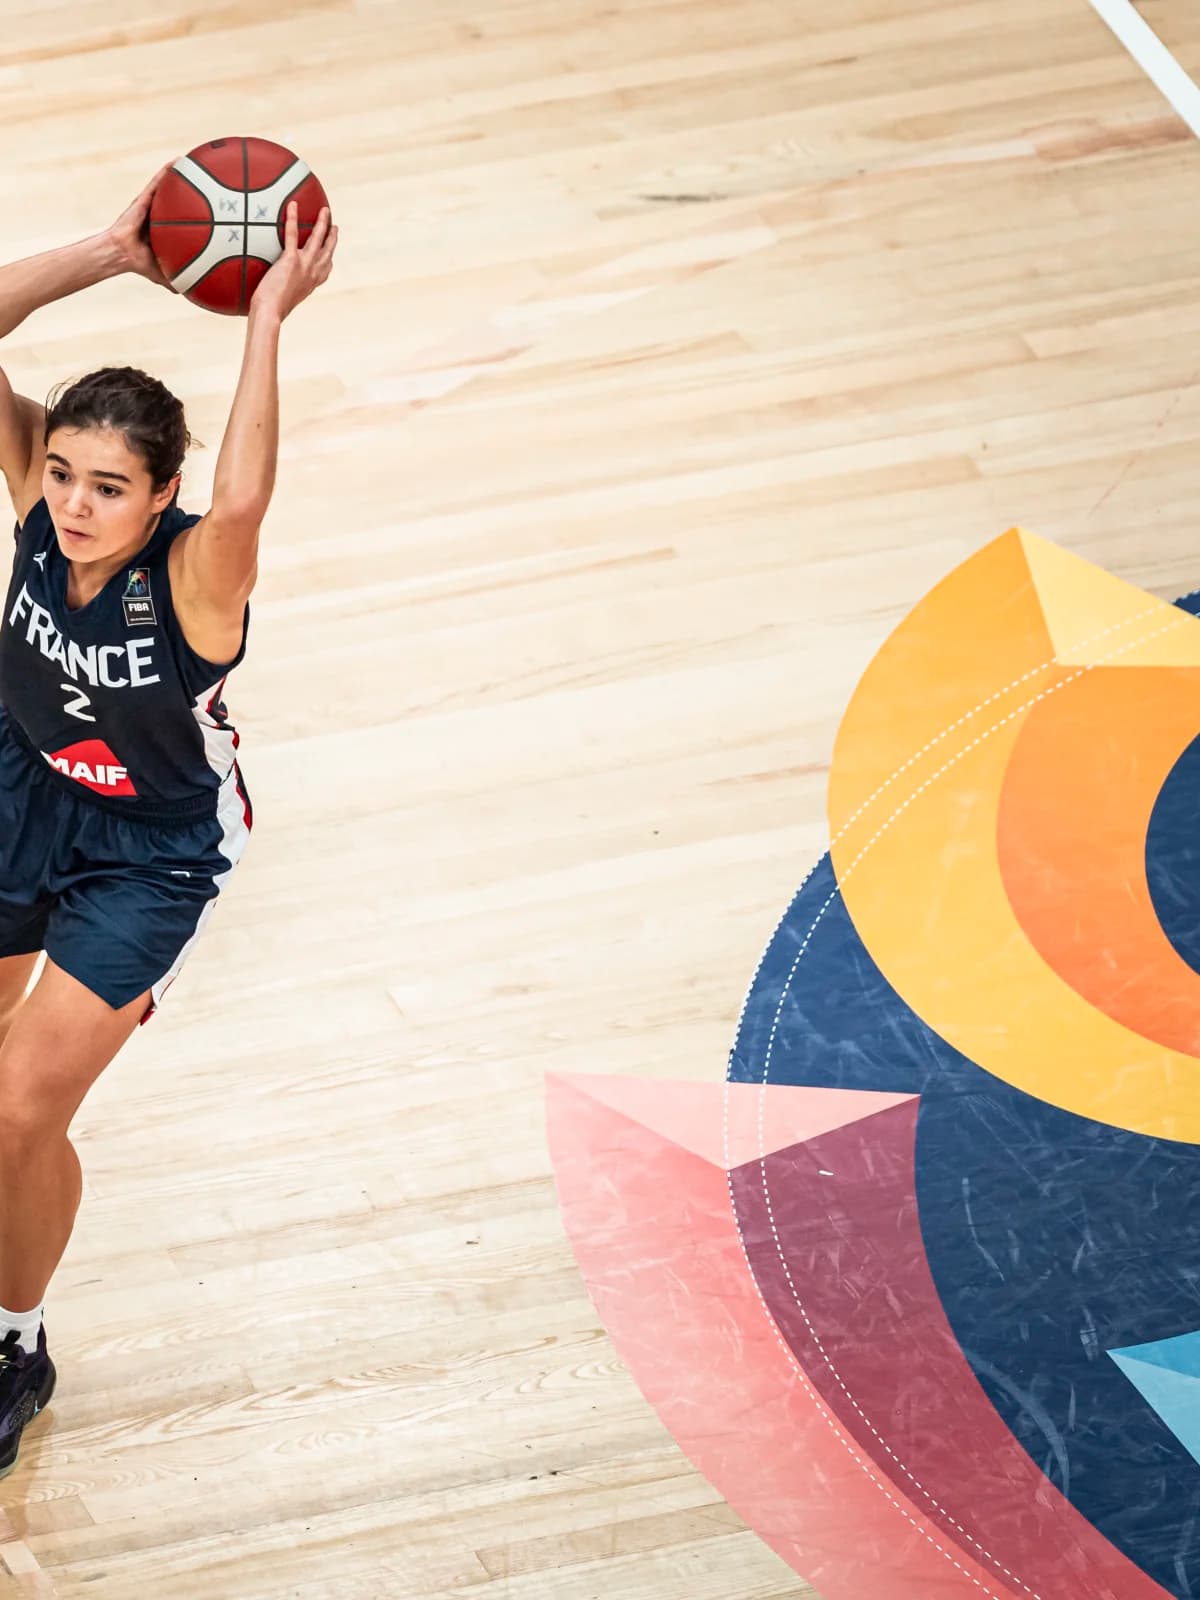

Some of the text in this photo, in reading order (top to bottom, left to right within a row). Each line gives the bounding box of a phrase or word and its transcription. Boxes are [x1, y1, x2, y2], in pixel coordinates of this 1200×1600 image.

[128, 603, 149, 612] FIBA
[9, 581, 161, 688] FRANCE
[60, 683, 97, 722] 2
[40, 750, 128, 786] MAIF
